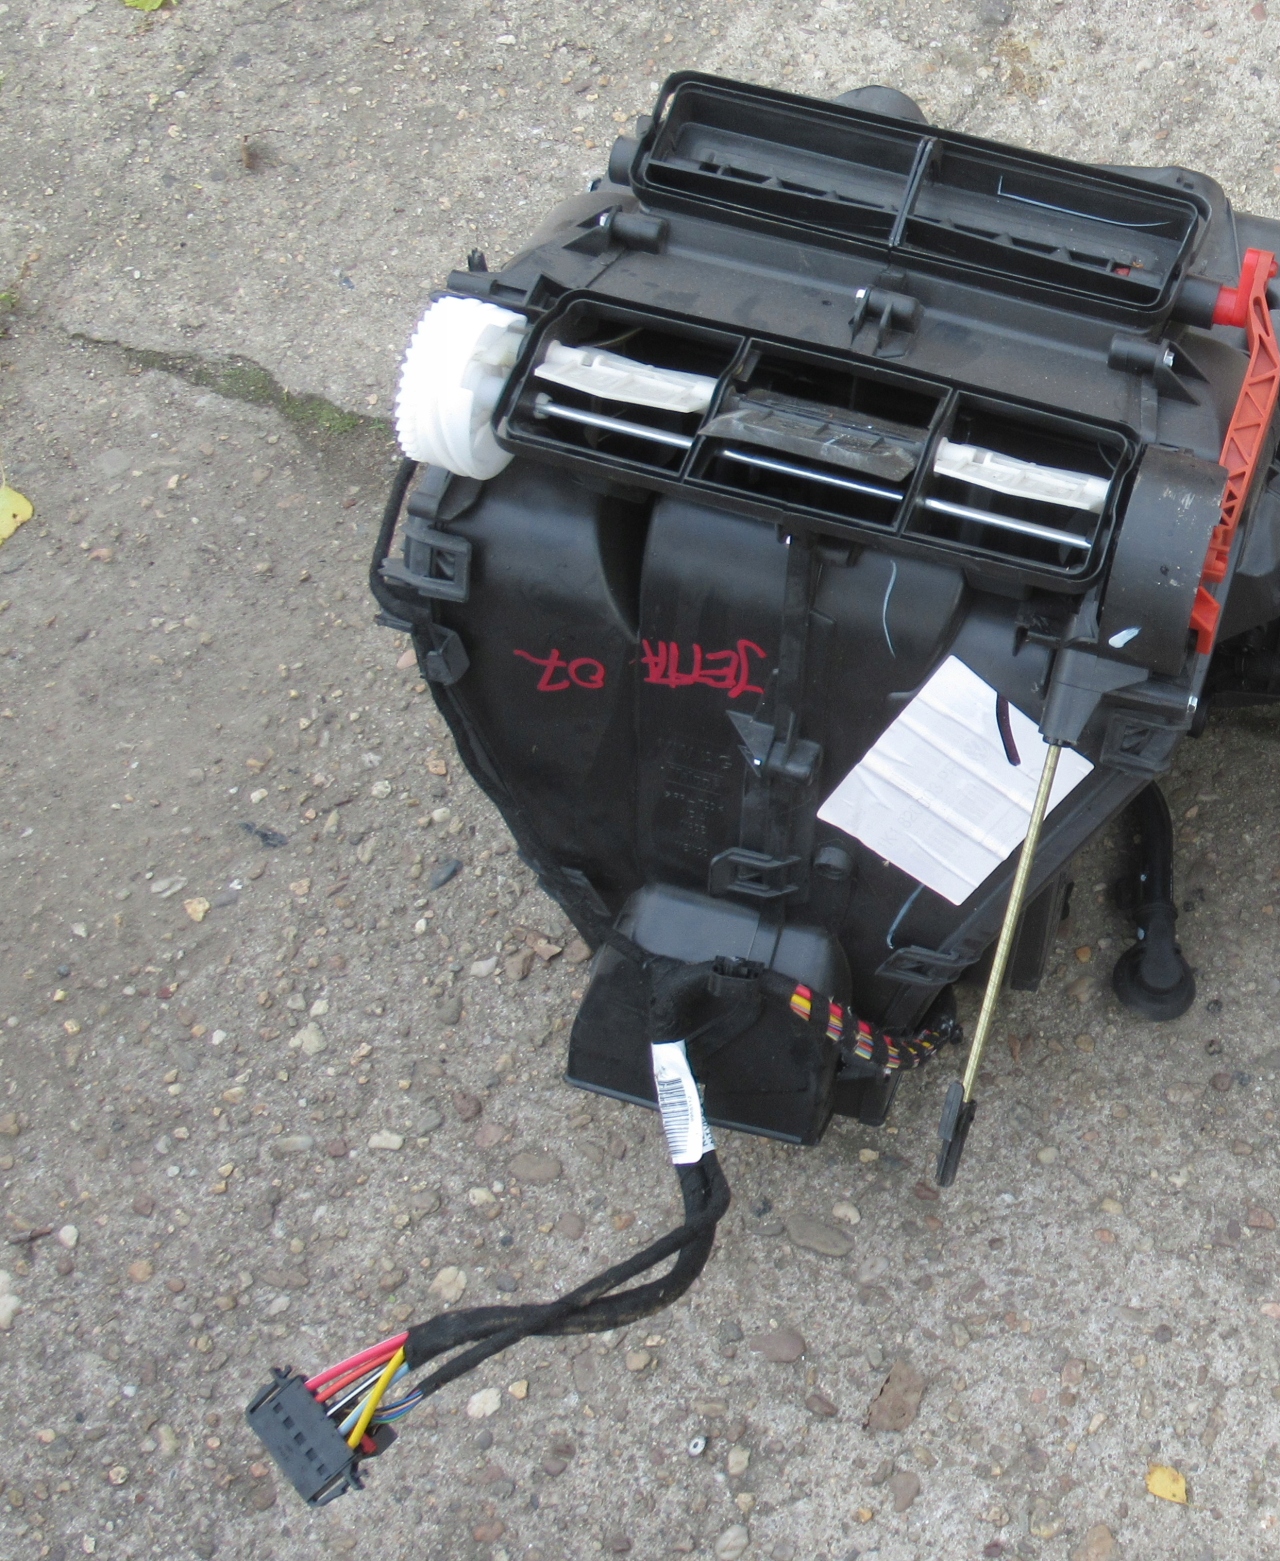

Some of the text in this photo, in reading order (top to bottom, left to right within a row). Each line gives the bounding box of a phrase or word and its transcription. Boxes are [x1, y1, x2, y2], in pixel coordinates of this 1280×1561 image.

[513, 638, 767, 698] JETTA 07
[899, 803, 923, 829] 820
